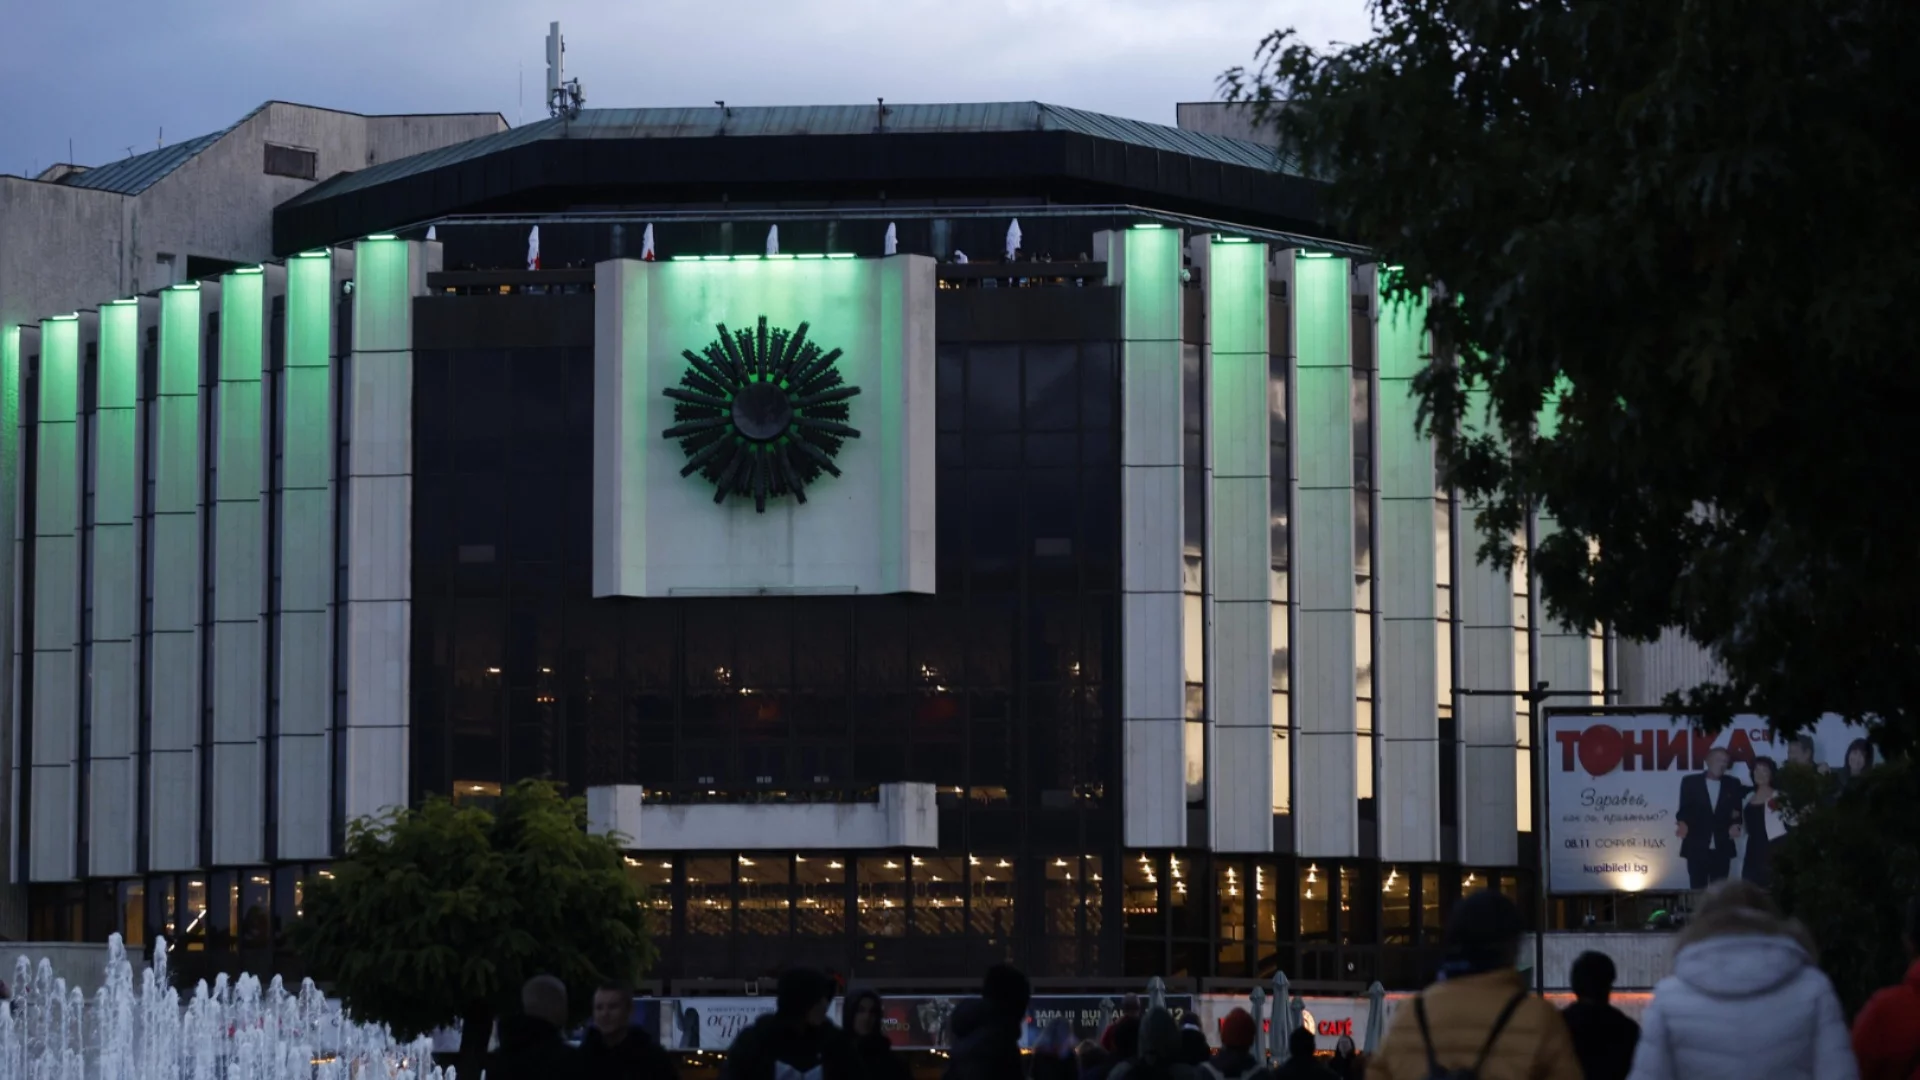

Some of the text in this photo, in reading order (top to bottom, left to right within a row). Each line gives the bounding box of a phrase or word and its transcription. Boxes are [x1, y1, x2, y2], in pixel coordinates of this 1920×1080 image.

[1556, 724, 1756, 777] ТОНИКА
[1583, 862, 1648, 875] kupibileti.bg
[1318, 1018, 1353, 1036] CAFÉ
